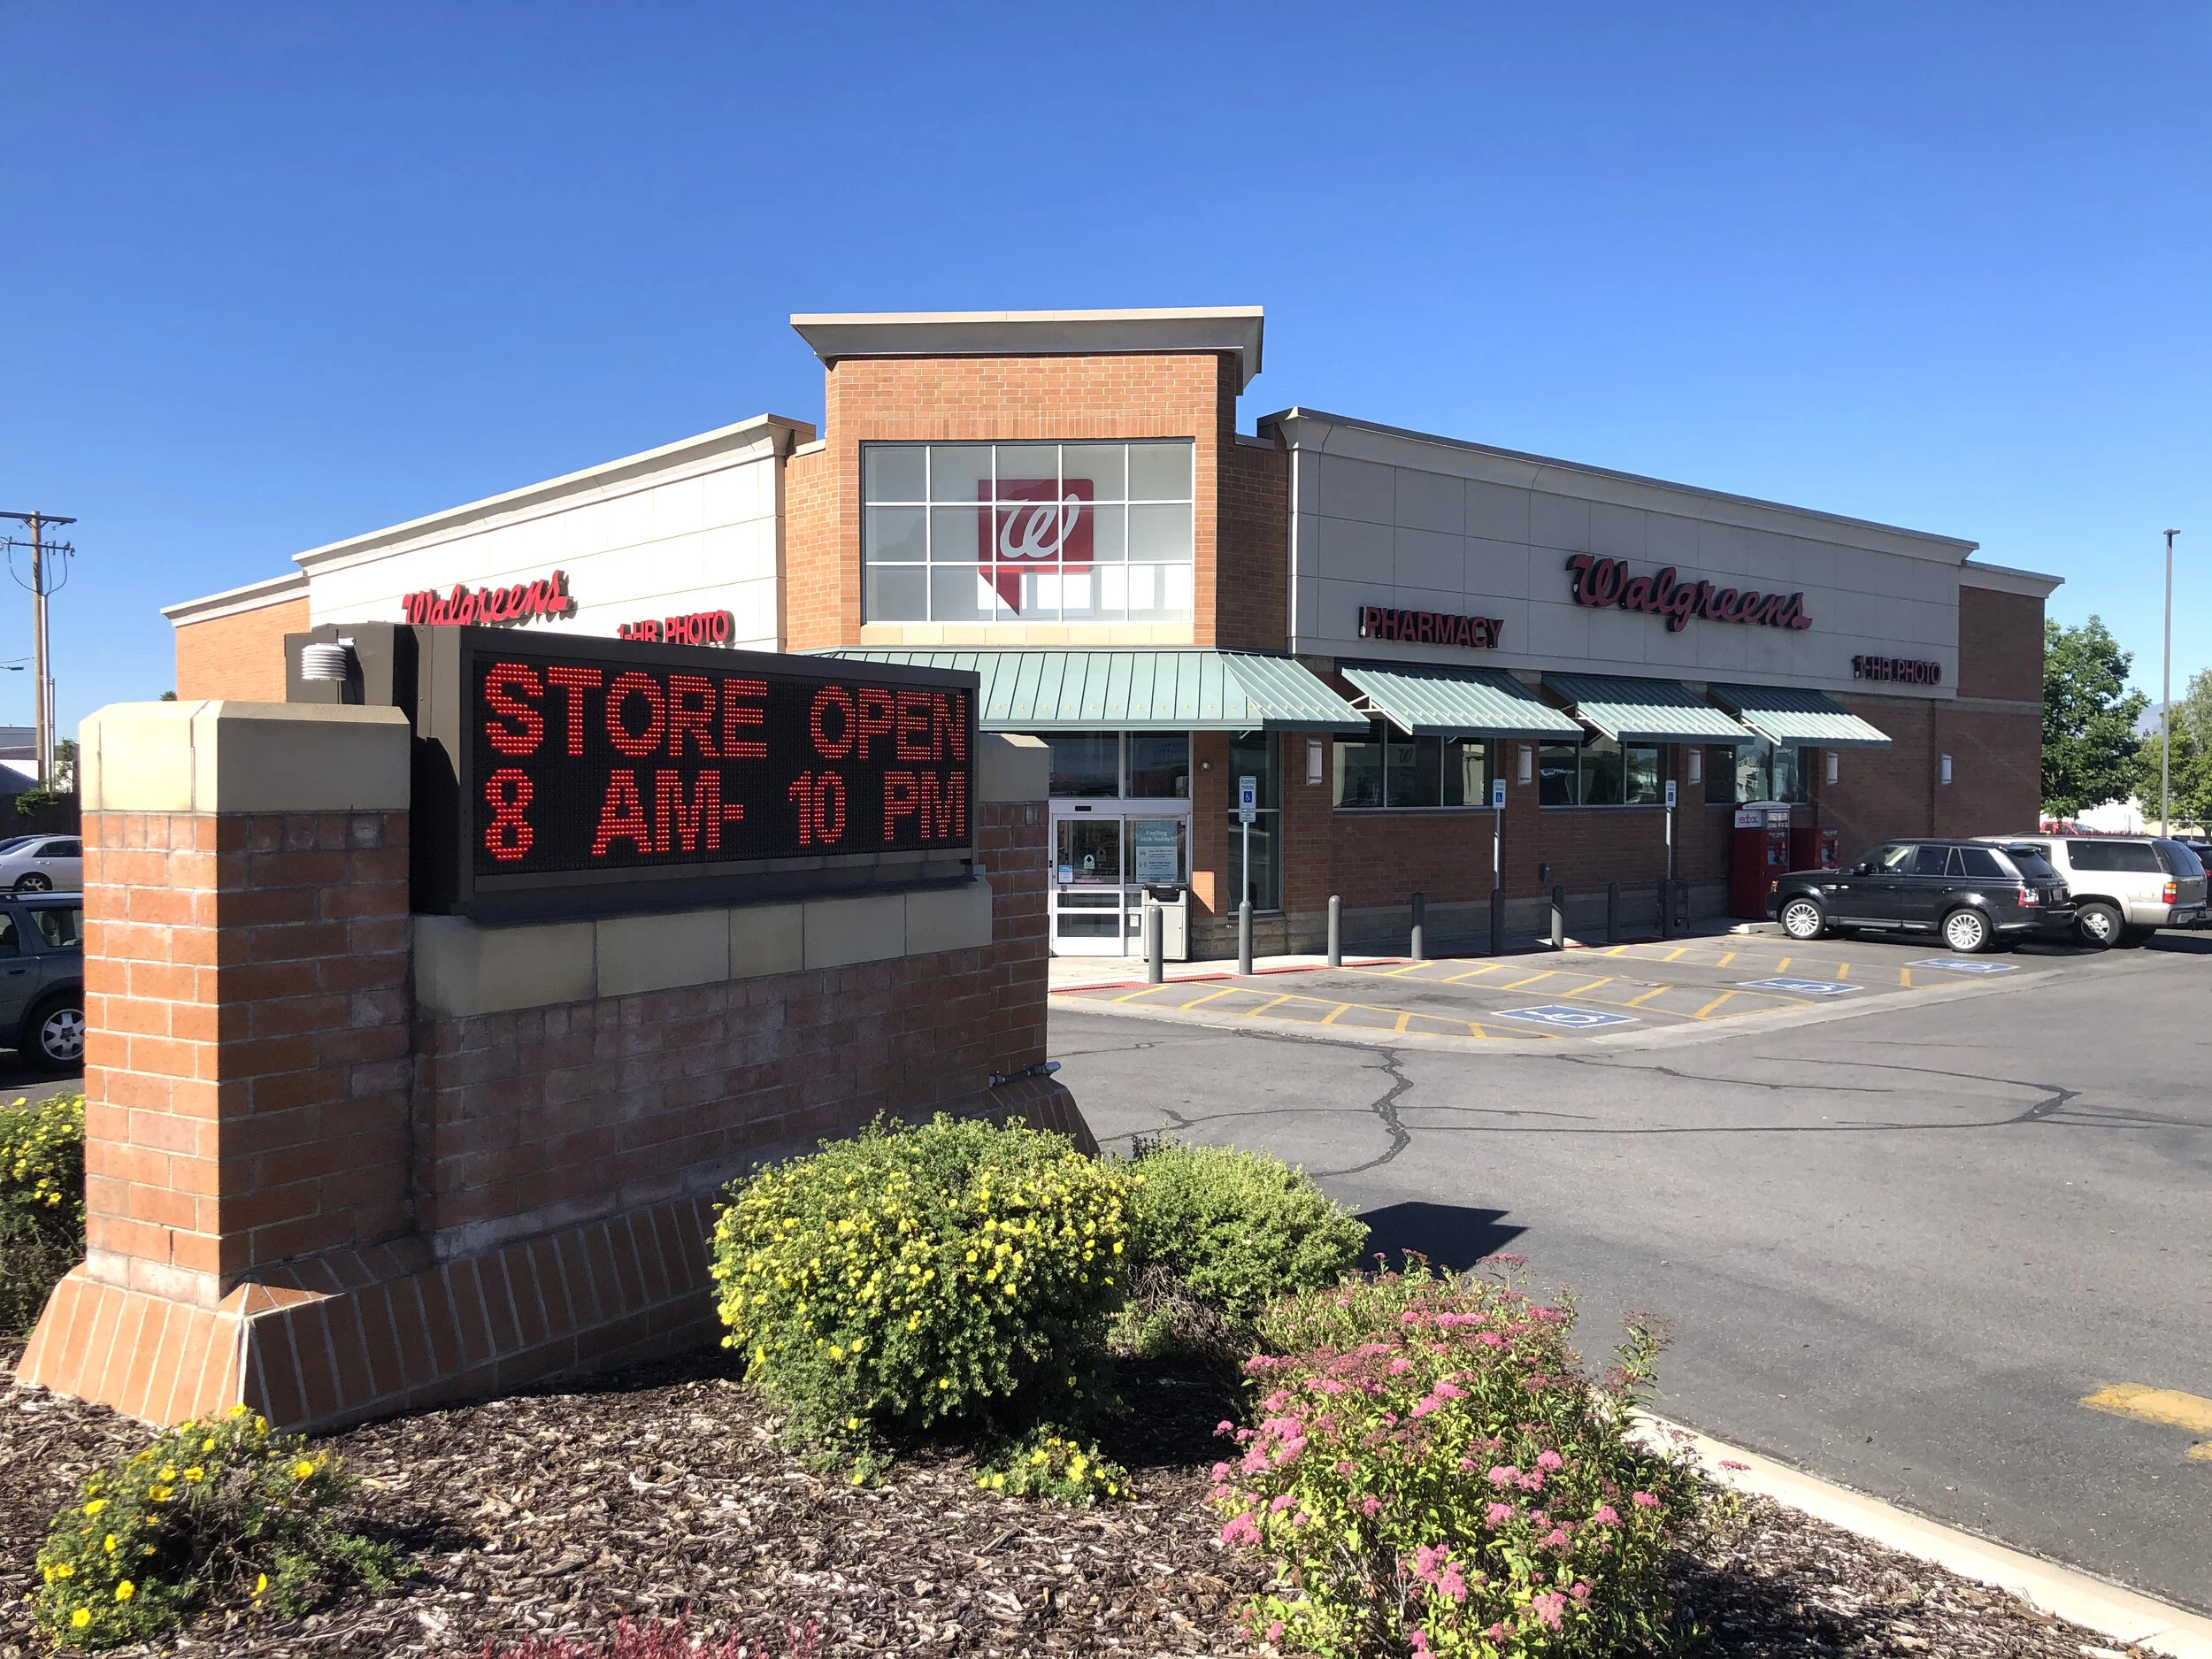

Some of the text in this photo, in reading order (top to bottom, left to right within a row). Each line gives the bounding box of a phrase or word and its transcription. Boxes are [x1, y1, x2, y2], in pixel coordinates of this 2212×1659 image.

[403, 569, 572, 626] Walgreens
[1566, 554, 1811, 632] Walgreens
[618, 610, 730, 645] 1-HR PHOTO
[1359, 605, 1504, 649] PHARMACY
[1852, 655, 1942, 685] 1-HR PHOTO
[484, 662, 966, 761] STORE OPEN
[484, 767, 534, 862] 8
[788, 771, 847, 845] 10
[883, 771, 966, 841] PM
